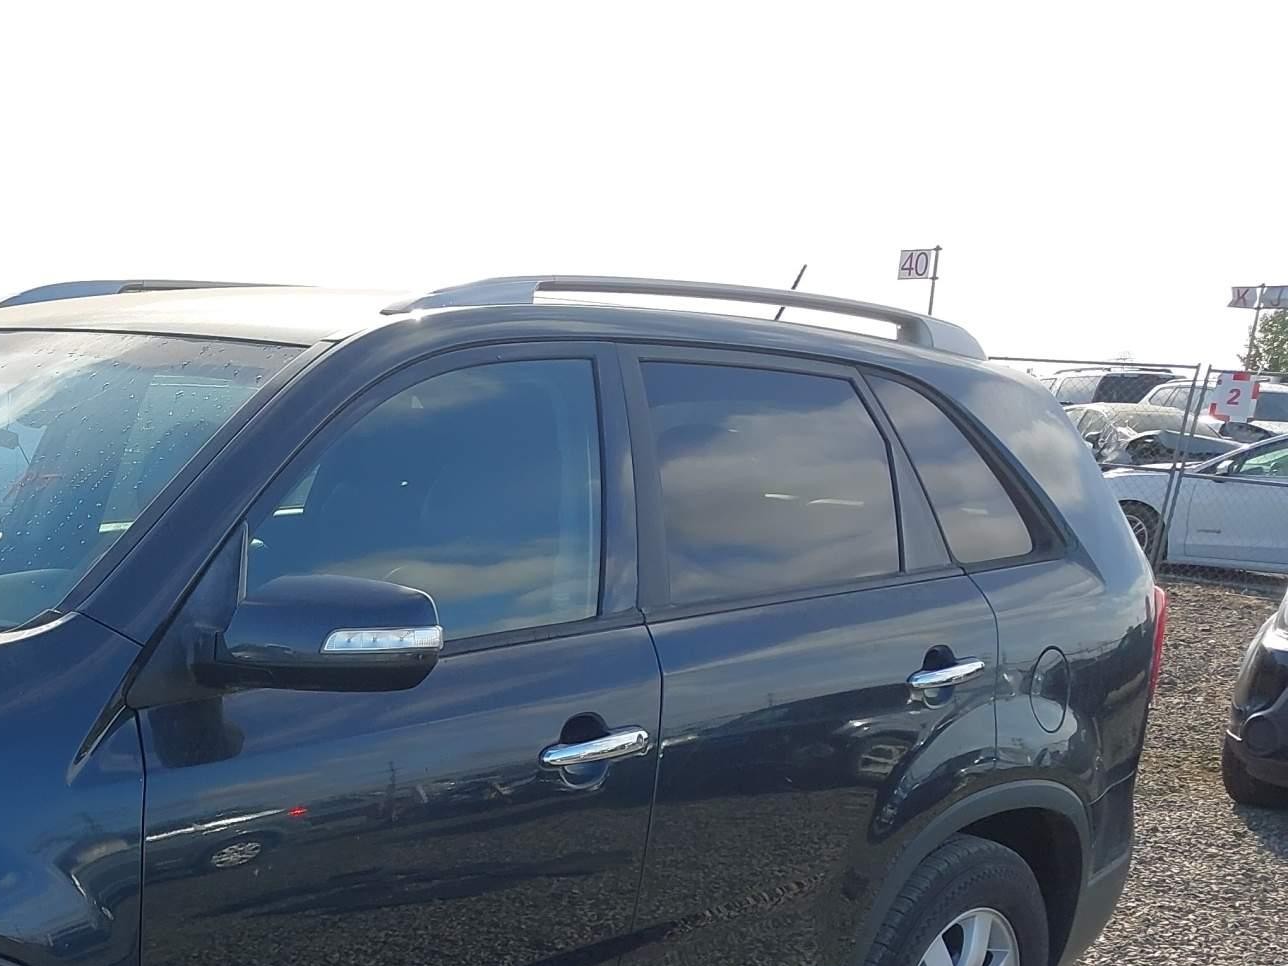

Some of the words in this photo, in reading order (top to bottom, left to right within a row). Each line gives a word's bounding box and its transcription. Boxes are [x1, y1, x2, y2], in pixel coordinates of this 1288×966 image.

[901, 251, 929, 277] 40
[1234, 288, 1250, 307] K
[1226, 388, 1242, 406] 2
